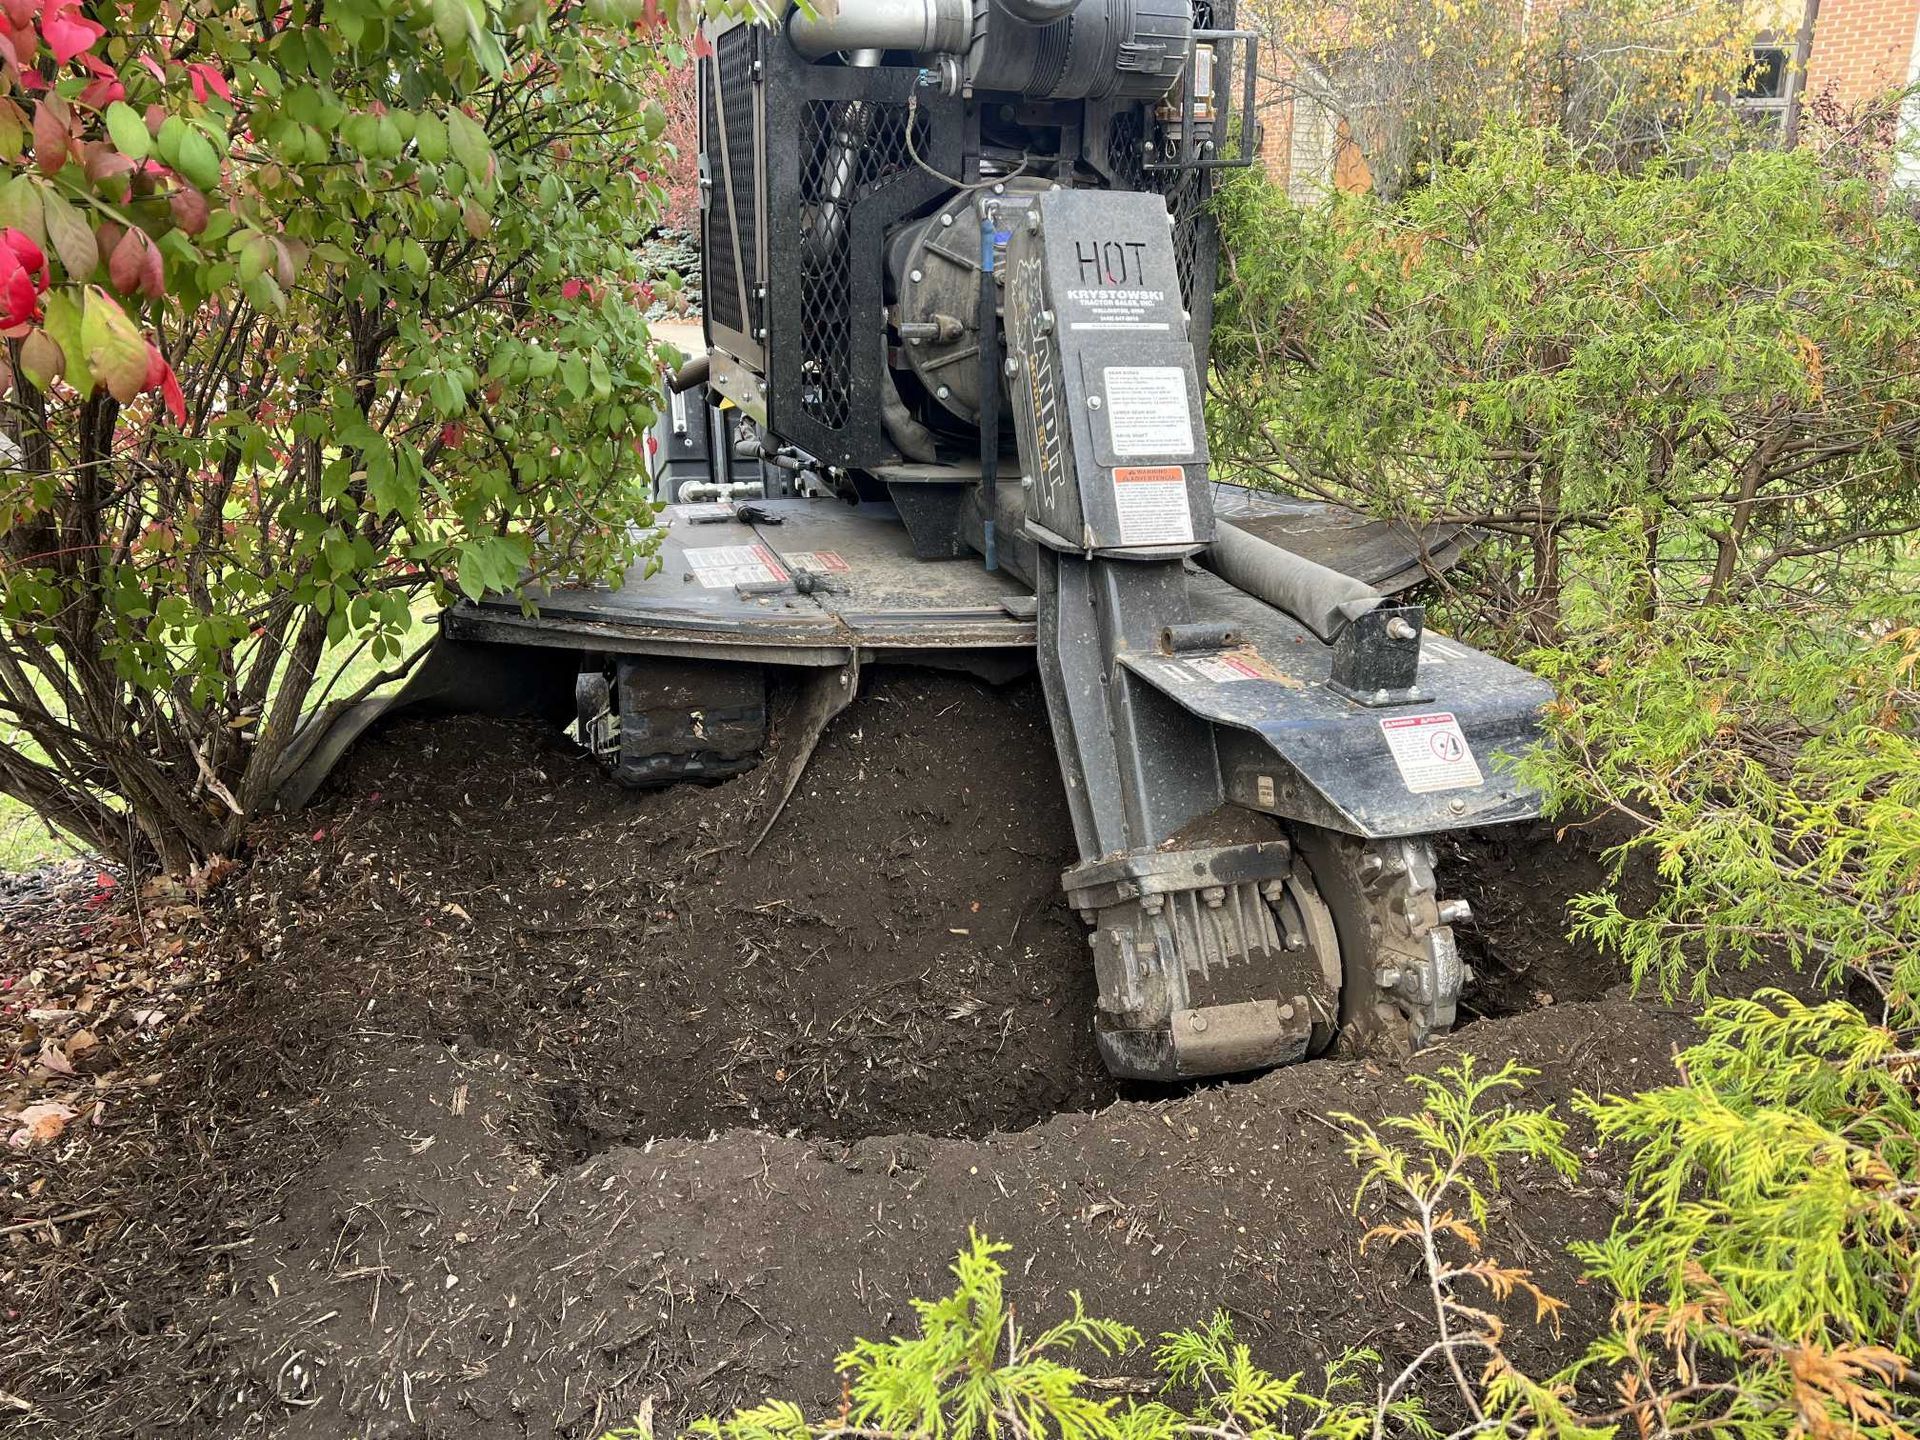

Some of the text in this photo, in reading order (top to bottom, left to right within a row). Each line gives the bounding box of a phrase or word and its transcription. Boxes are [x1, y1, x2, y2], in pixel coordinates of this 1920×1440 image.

[1076, 241, 1146, 286] HOT
[1067, 290, 1164, 301] KRYSTOWSKI
[1030, 354, 1042, 418] MODEL
[1030, 312, 1066, 487] ANDIT
